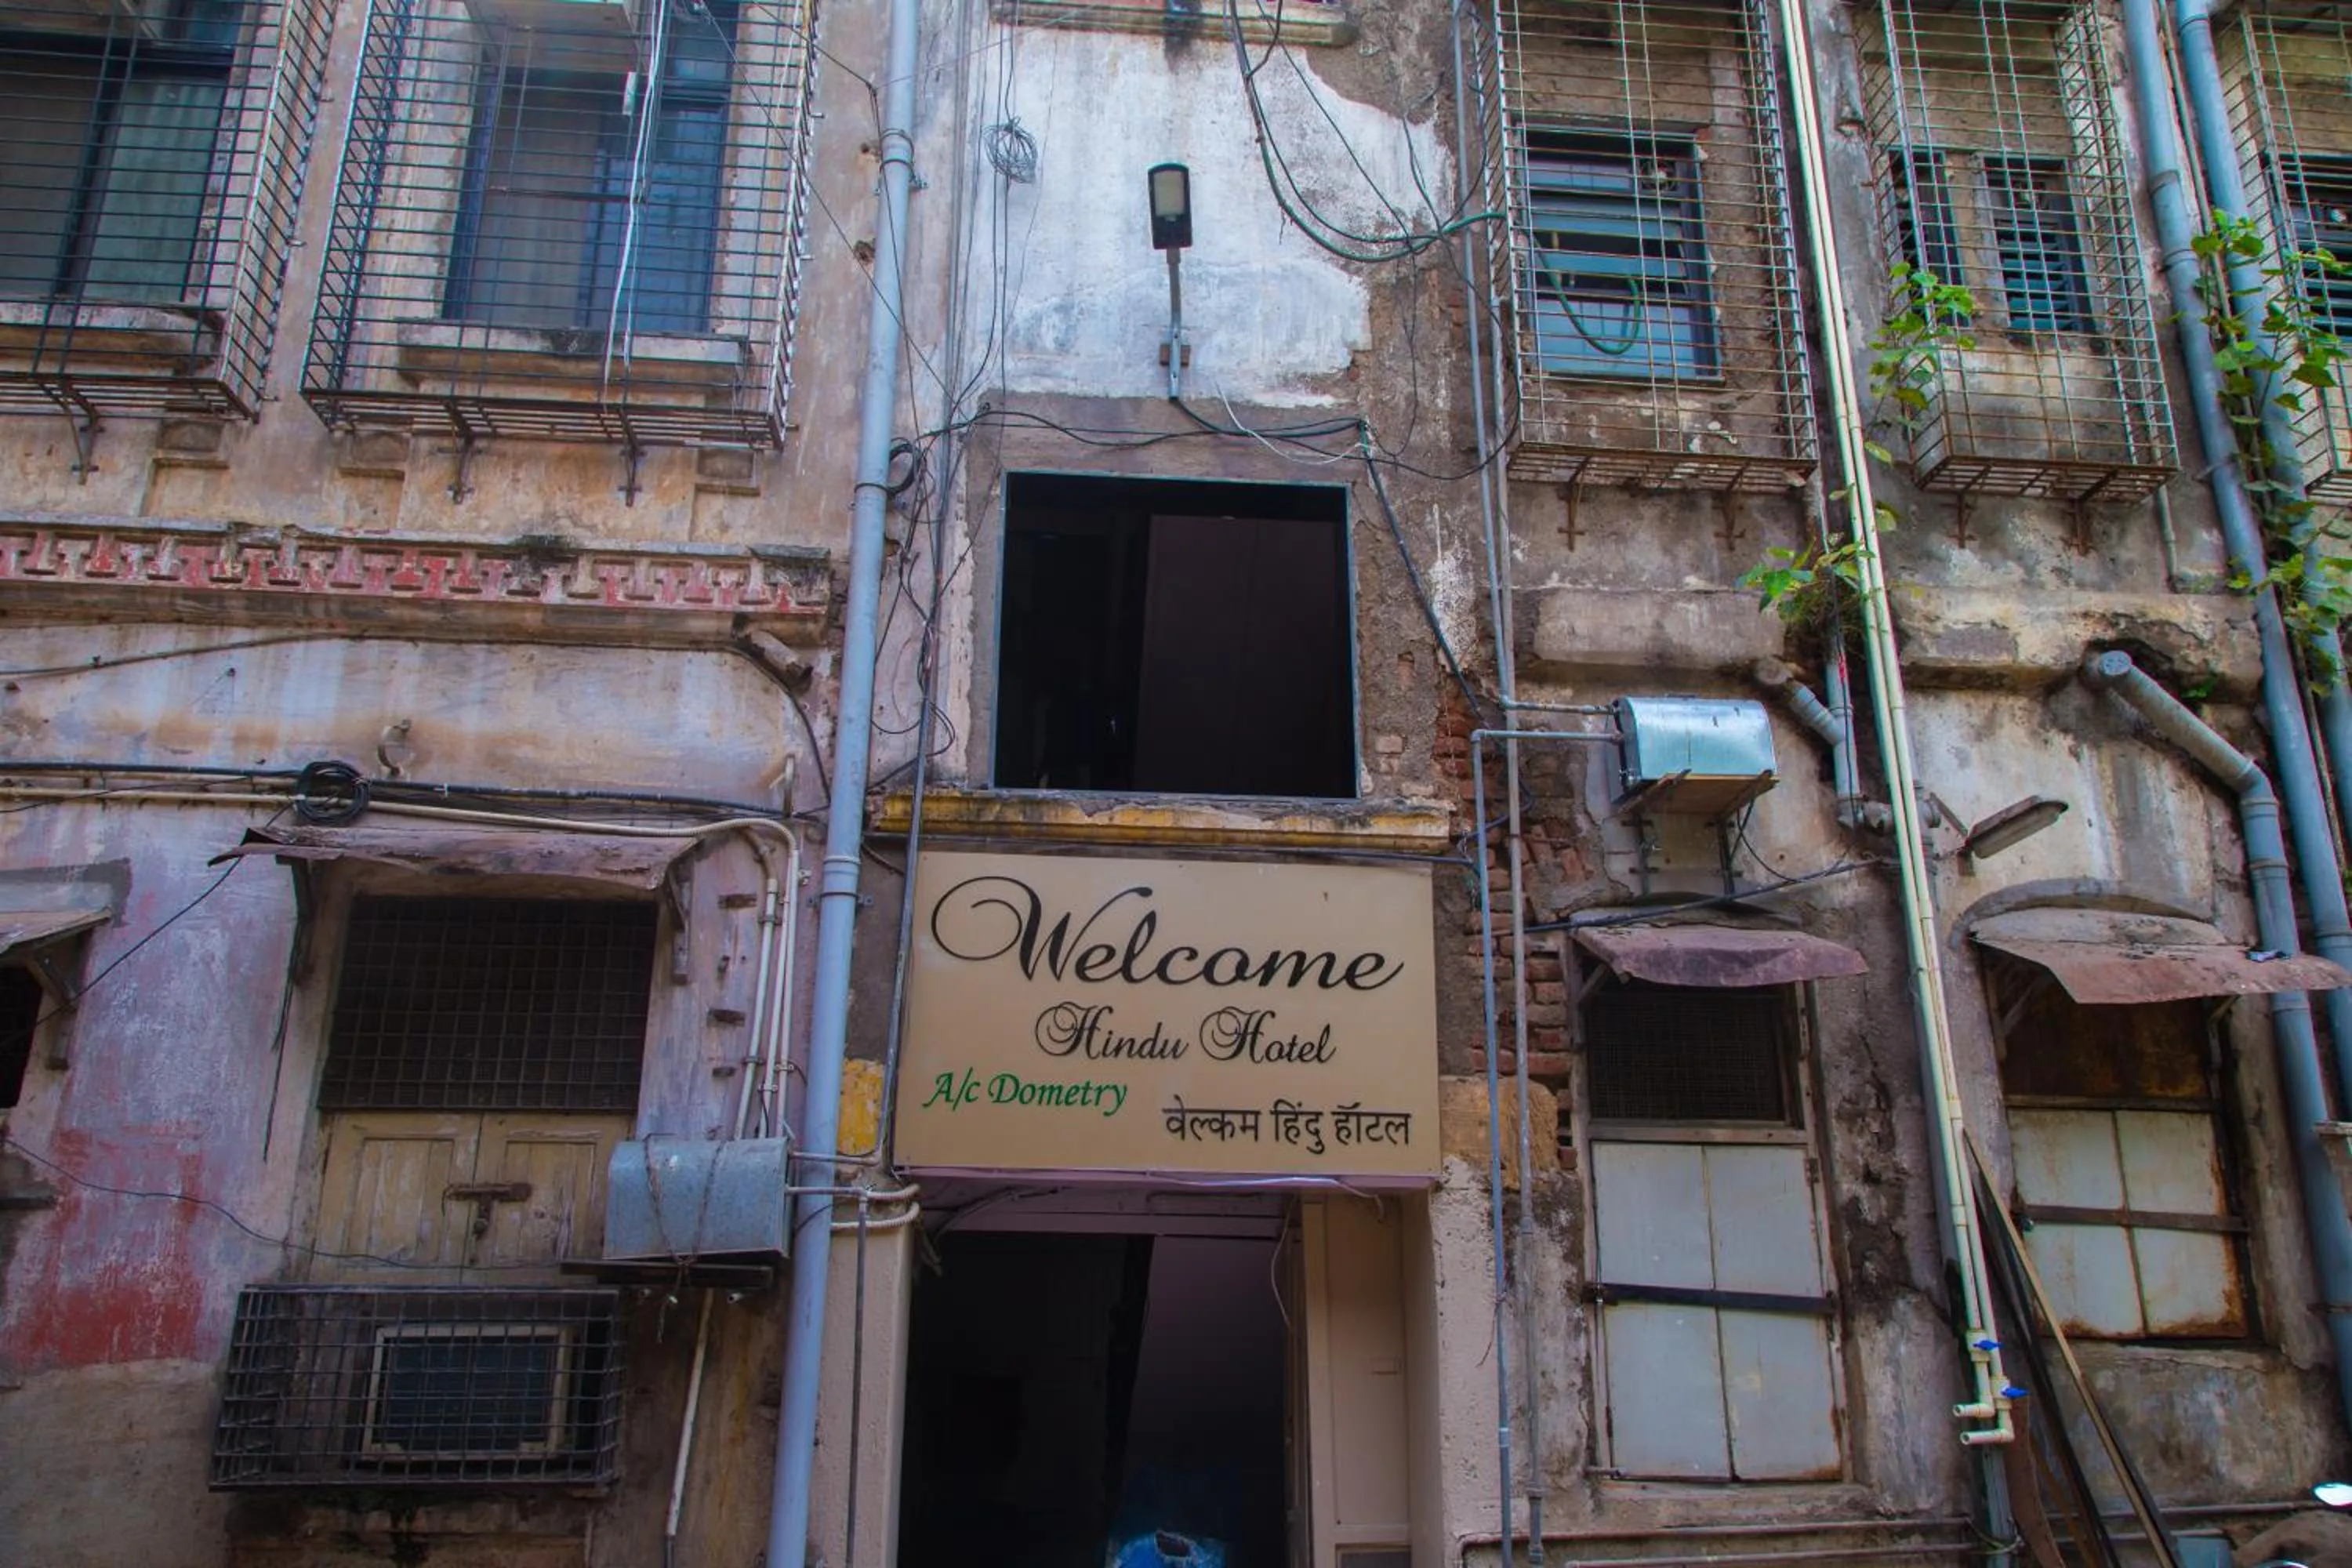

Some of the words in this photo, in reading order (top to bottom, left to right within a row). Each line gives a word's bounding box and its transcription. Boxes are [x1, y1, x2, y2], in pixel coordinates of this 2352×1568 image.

[931, 875, 1405, 990] Welcome
[1035, 1001, 1189, 1058] Hindu
[1200, 1005, 1337, 1064] Hotel
[988, 1073, 1127, 1116] Dometry
